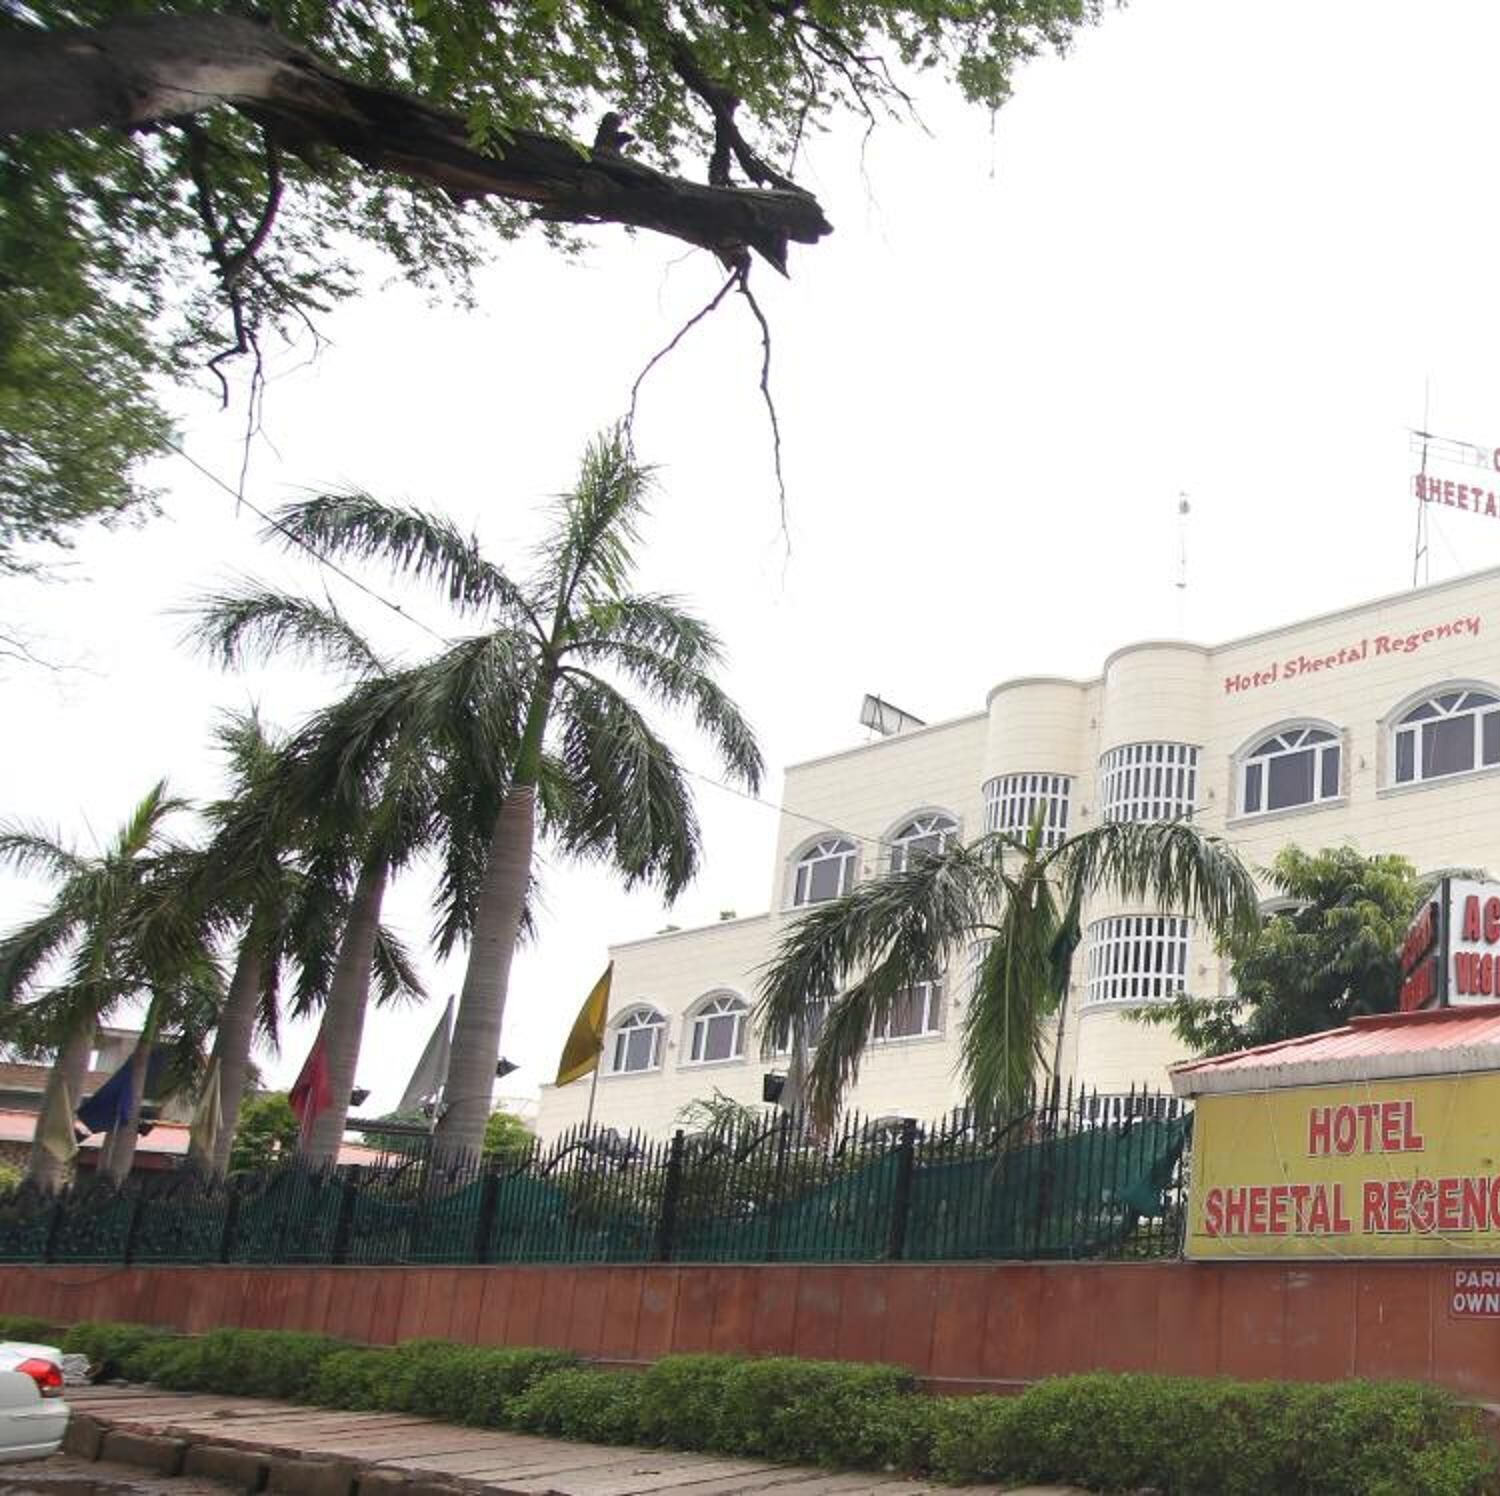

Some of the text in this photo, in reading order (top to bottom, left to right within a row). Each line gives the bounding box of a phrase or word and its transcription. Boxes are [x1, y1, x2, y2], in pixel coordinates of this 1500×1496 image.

[1224, 616, 1480, 694] Hotel Sheetal Regency
[1455, 952, 1492, 994] VEG
[1308, 1101, 1423, 1155] HOTEL
[1205, 1184, 1352, 1236] SHEETAL
